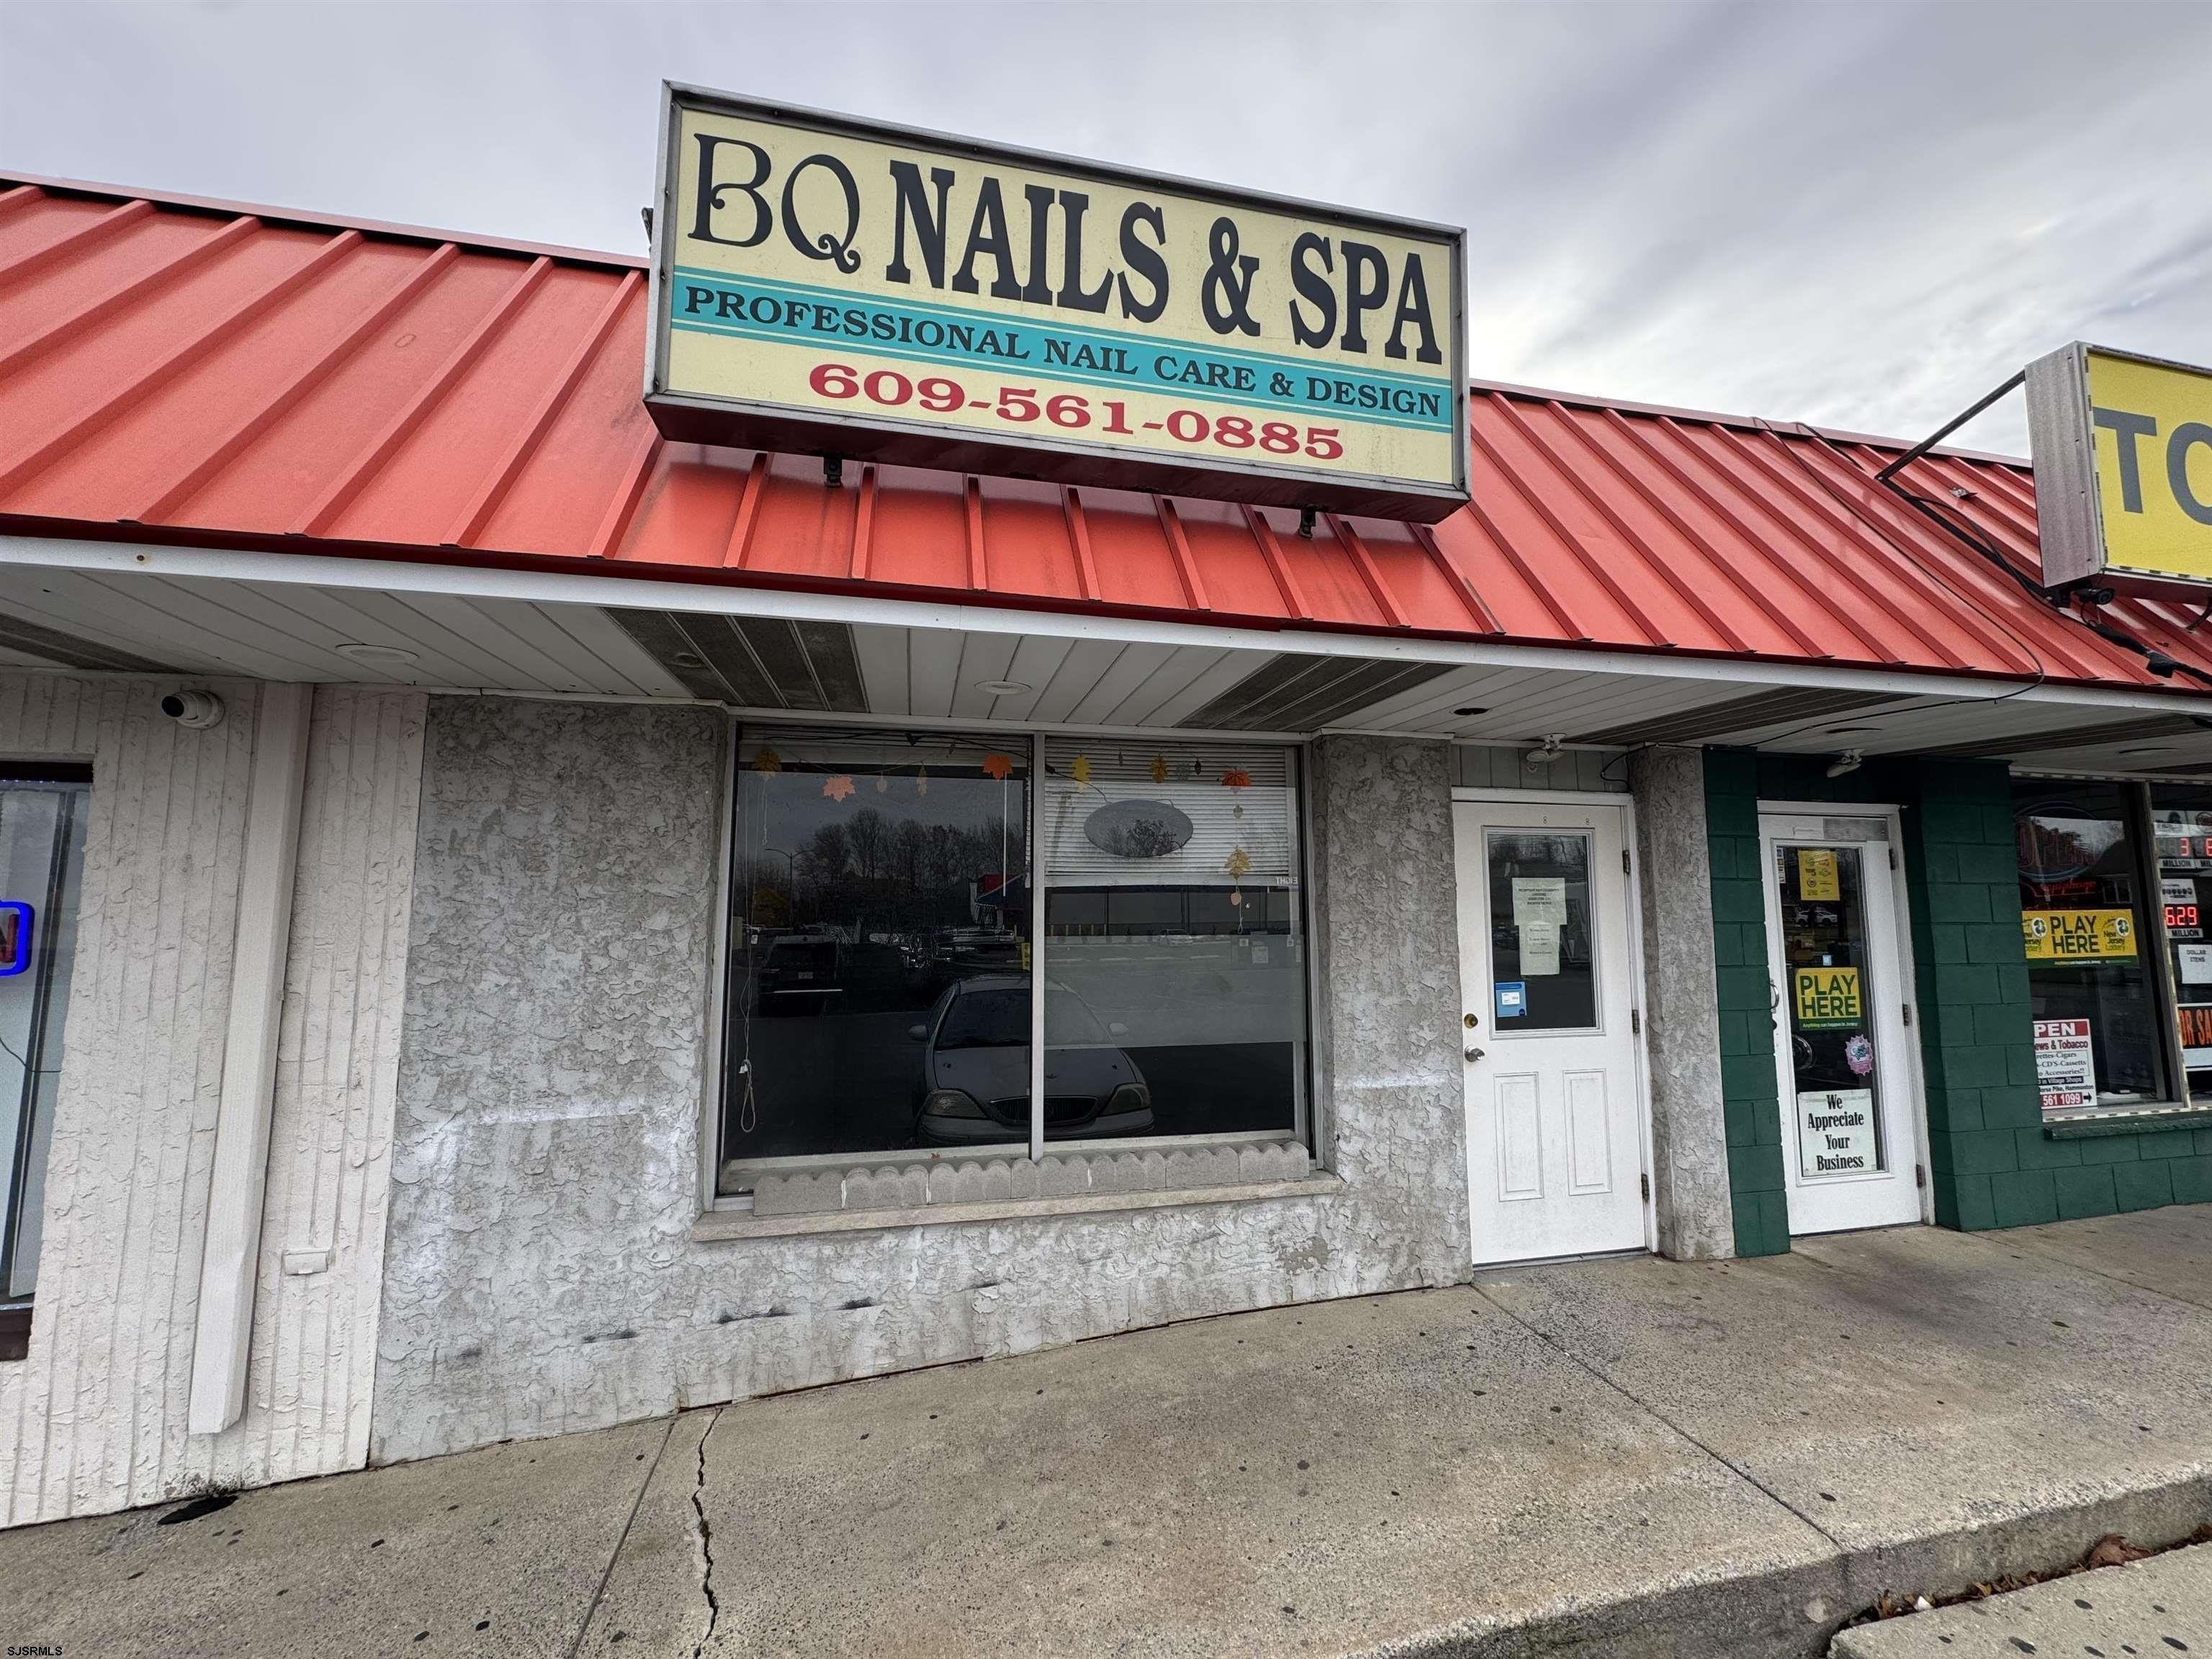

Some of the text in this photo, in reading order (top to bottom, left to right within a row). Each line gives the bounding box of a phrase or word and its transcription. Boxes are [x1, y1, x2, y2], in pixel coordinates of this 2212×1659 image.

[688, 133, 1442, 365] BQ NAILS & SPA
[685, 287, 1441, 418] PROFESSIONAL NAIL CARE & DESIGN
[809, 364, 1344, 459] 609-561-0885
[2180, 837, 2189, 857] 3
[2050, 915, 2097, 935] PLAY
[2165, 907, 2198, 926] 629
[2052, 935, 2100, 954] HERE
[1800, 974, 1856, 996] PLAY
[1801, 995, 1858, 1017] HERE
[2033, 1022, 2076, 1038] PEN
[2196, 1008, 2212, 1046] SA
[2051, 1040, 2056, 1050] &
[2057, 1039, 2088, 1050] Tobacco
[1826, 1094, 1843, 1110] We
[2043, 1093, 2082, 1106] 561 1099
[1808, 1111, 1864, 1131] Appreciate
[1825, 1134, 1850, 1150] Your
[1816, 1154, 1864, 1171] Business
